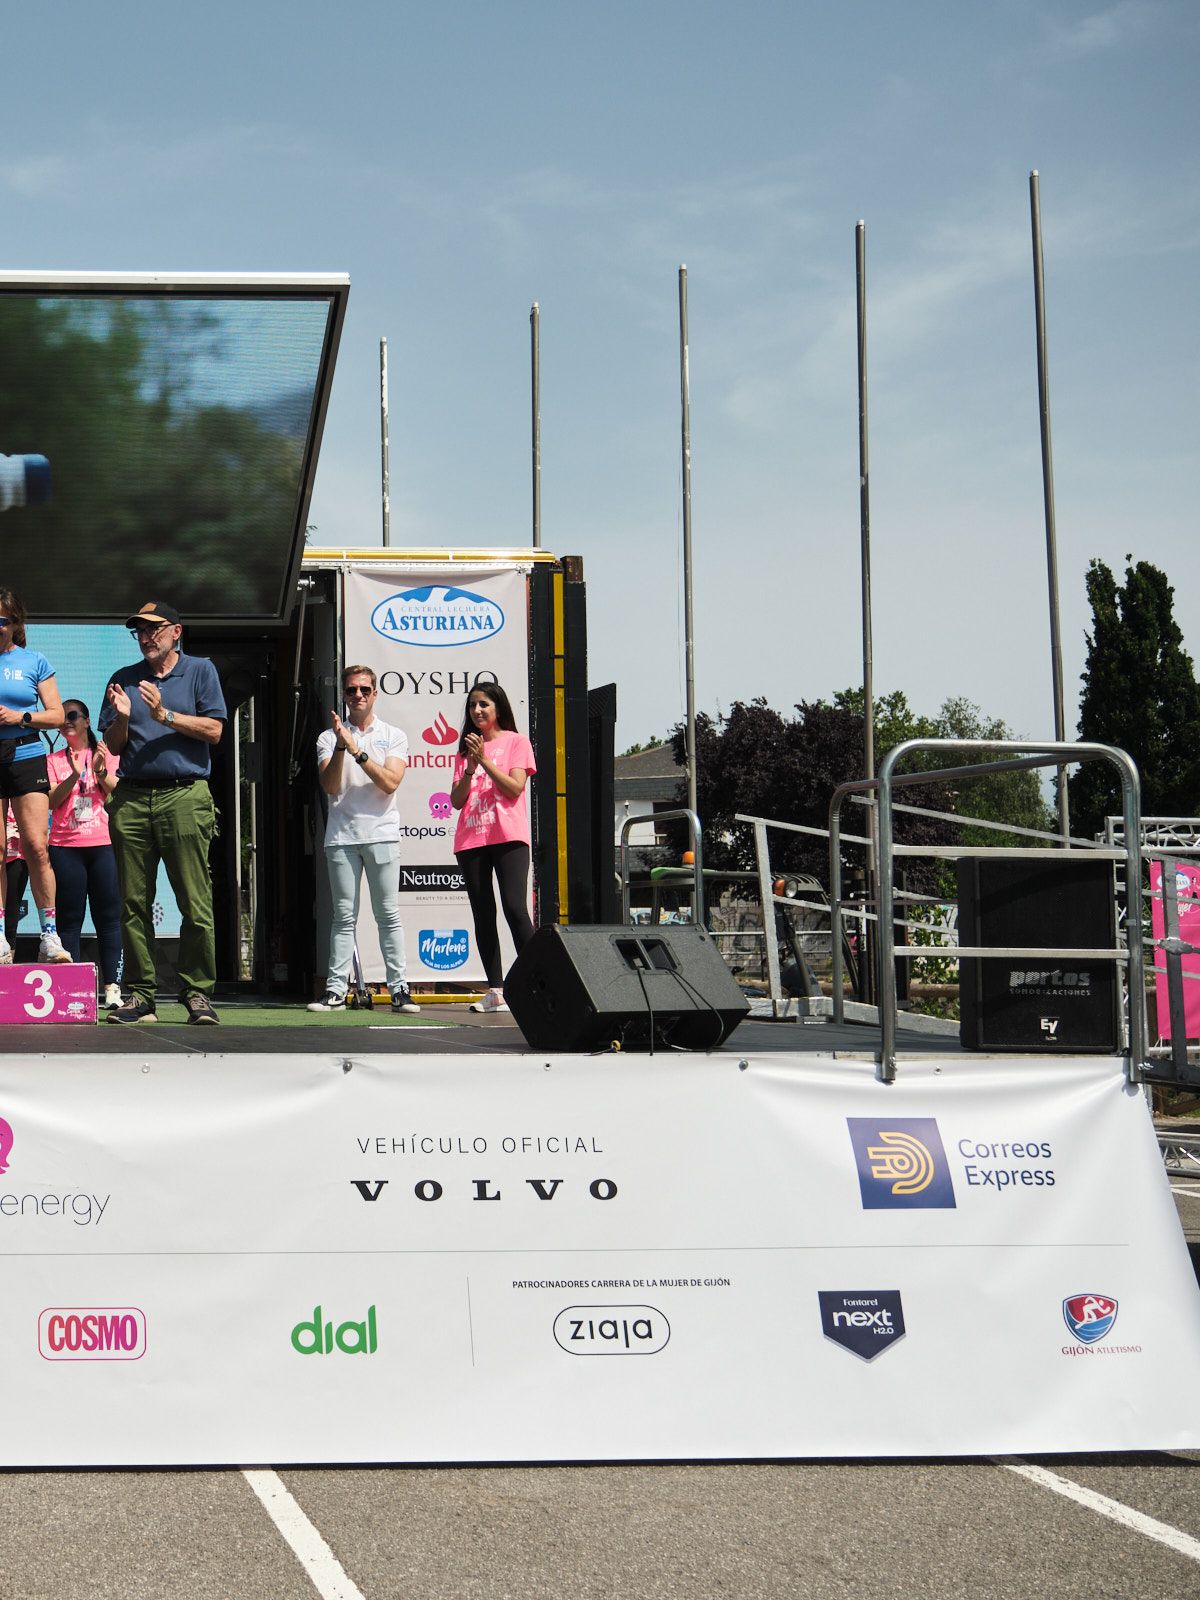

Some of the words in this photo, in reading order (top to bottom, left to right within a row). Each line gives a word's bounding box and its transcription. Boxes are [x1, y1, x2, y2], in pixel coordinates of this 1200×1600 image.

[382, 607, 495, 631] ASTURIANA
[401, 870, 466, 889] Neutroge
[23, 969, 55, 1019] 3
[356, 1133, 488, 1154] VEHÍCULO
[502, 1136, 604, 1153] OFICIAL
[958, 1138, 1052, 1159] Correos
[964, 1165, 1056, 1191] Express
[350, 1178, 618, 1201] VOLVO
[512, 1280, 589, 1289] PATROCINADORES
[591, 1280, 631, 1288] CARRERA
[633, 1279, 645, 1288] DE
[646, 1279, 658, 1288] LA
[660, 1279, 689, 1287] MUJER
[690, 1279, 702, 1287] DE
[704, 1277, 731, 1287] GIJÓN
[843, 1298, 879, 1306] Fontarel
[832, 1308, 893, 1327] next
[48, 1314, 138, 1352] COSMO
[291, 1304, 378, 1355] dial
[1061, 1344, 1095, 1356] GIJÓN
[1096, 1346, 1142, 1355] ATLETISMO
